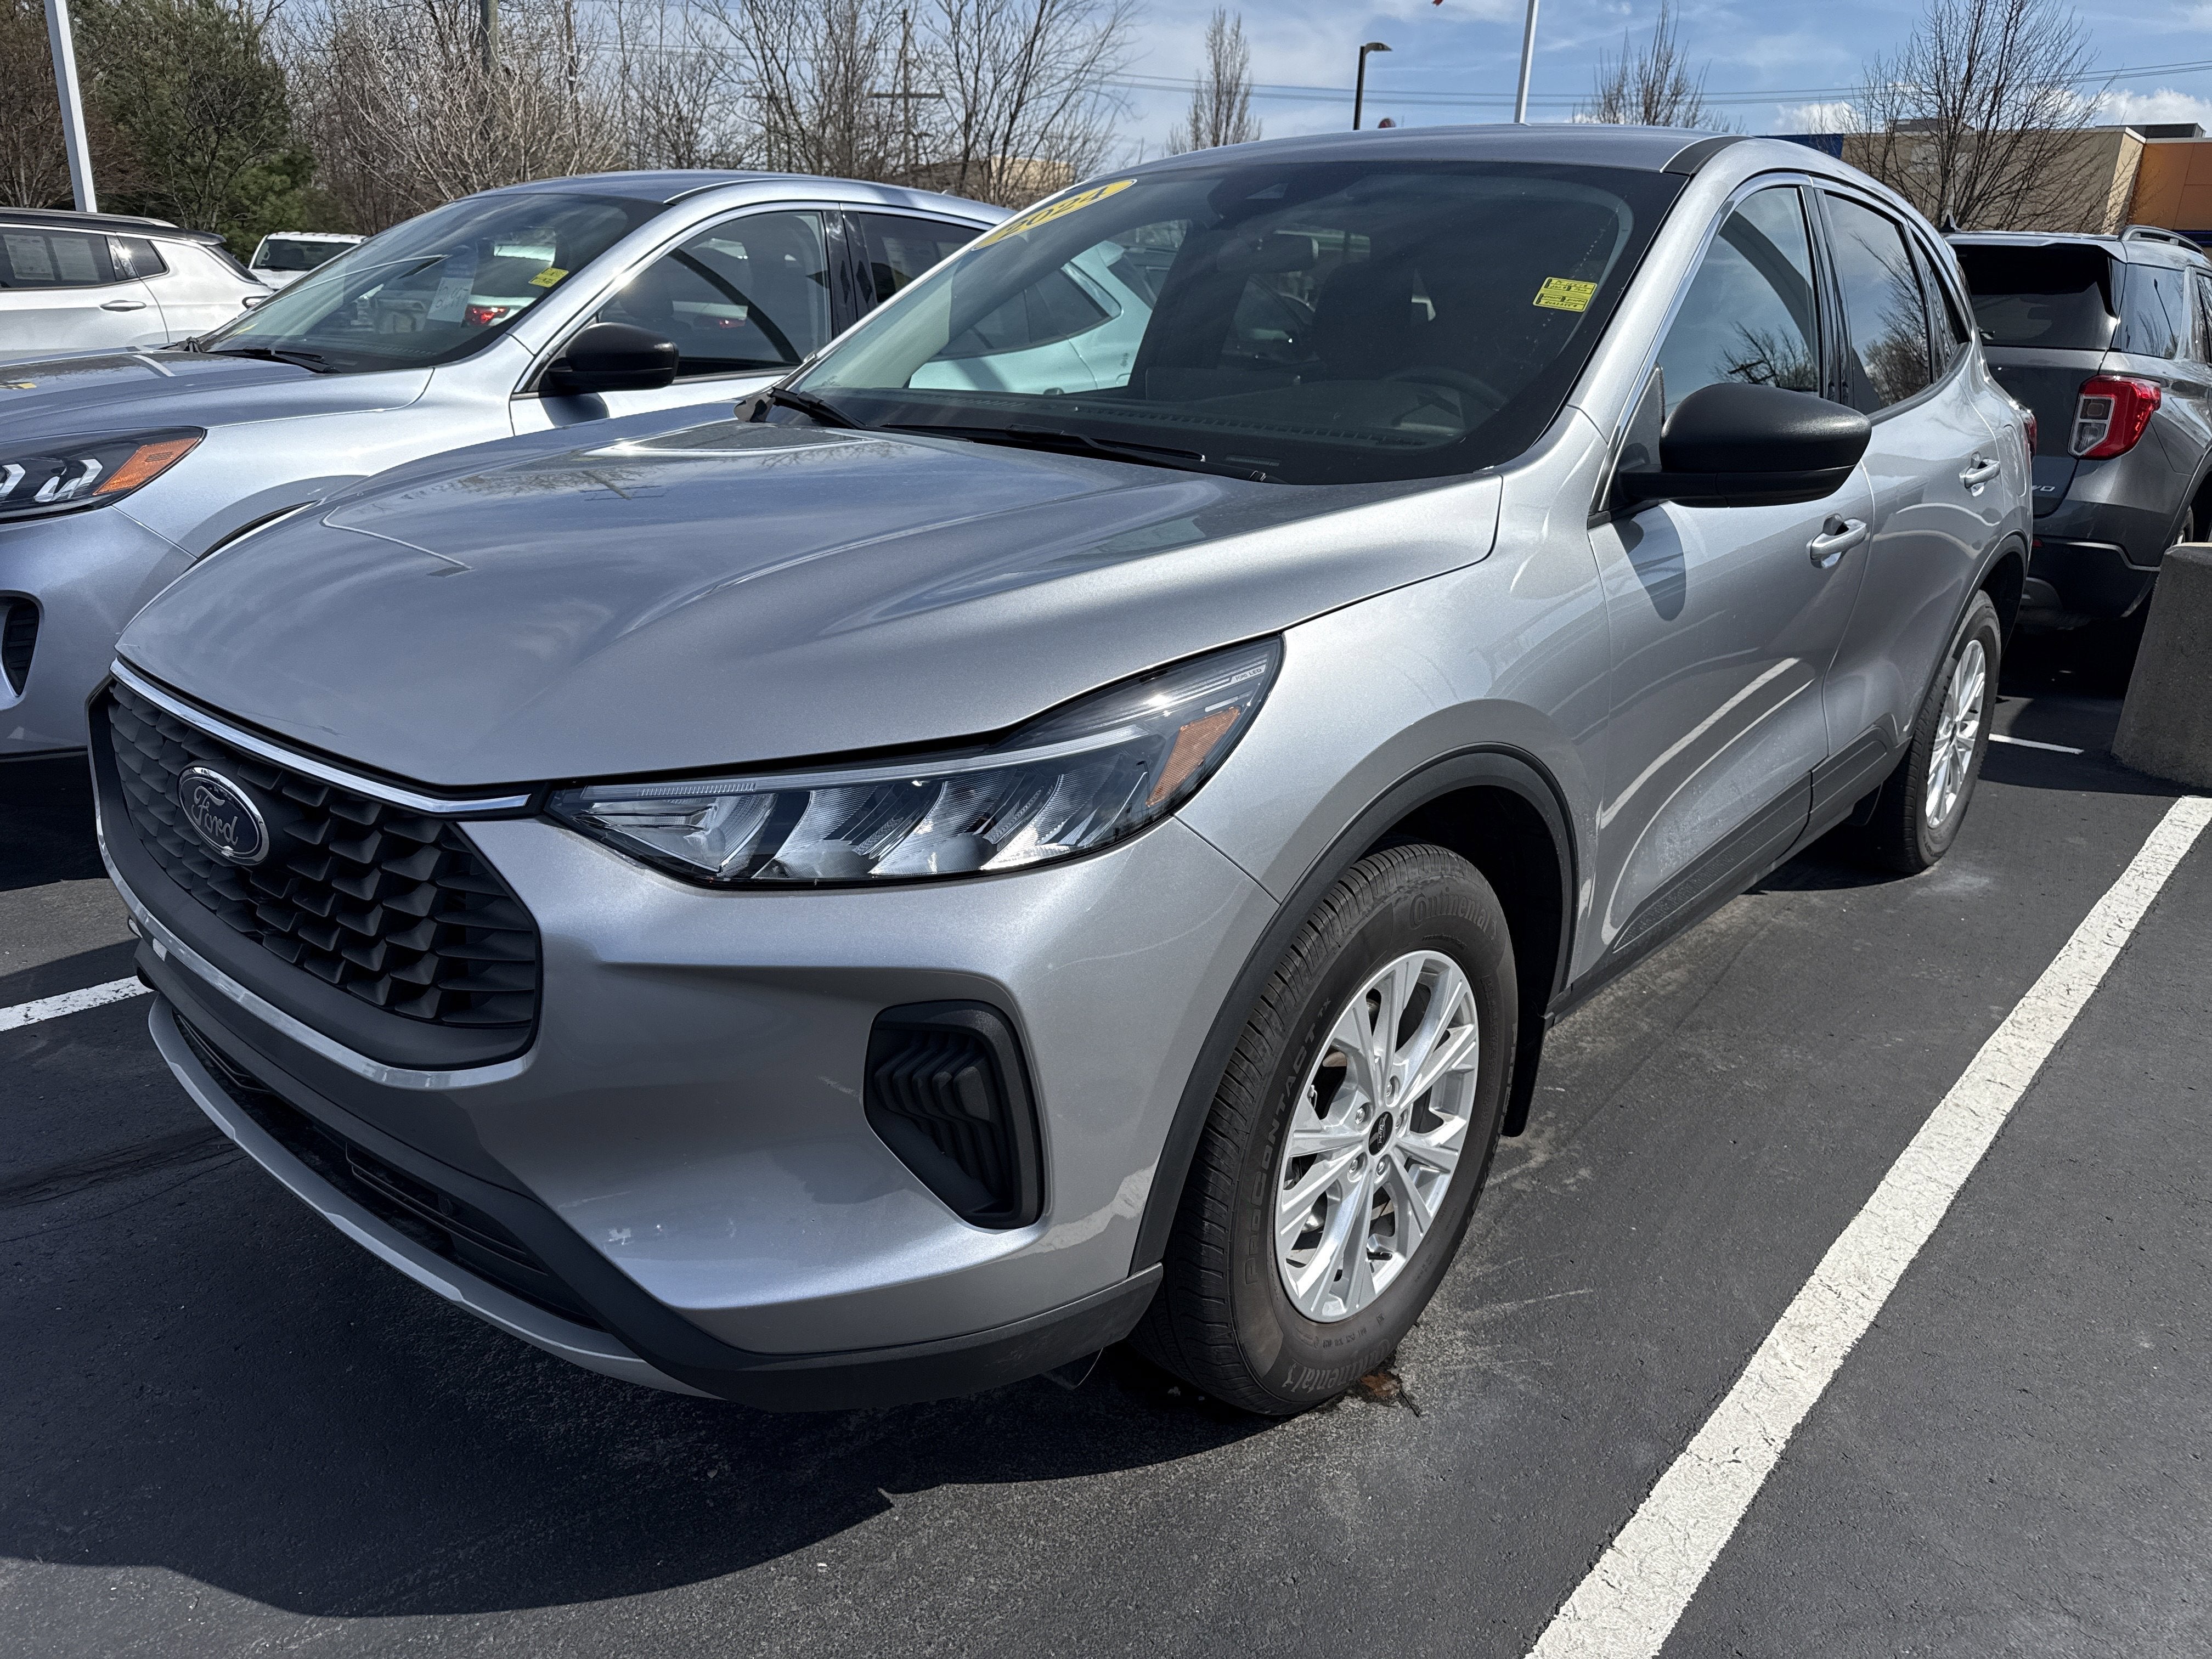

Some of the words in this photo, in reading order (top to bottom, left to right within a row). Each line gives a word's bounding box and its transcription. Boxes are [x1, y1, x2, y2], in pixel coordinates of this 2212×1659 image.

[998, 186, 1109, 240] 2024
[191, 785, 239, 846] Ford
[1409, 887, 1491, 933] Continental
